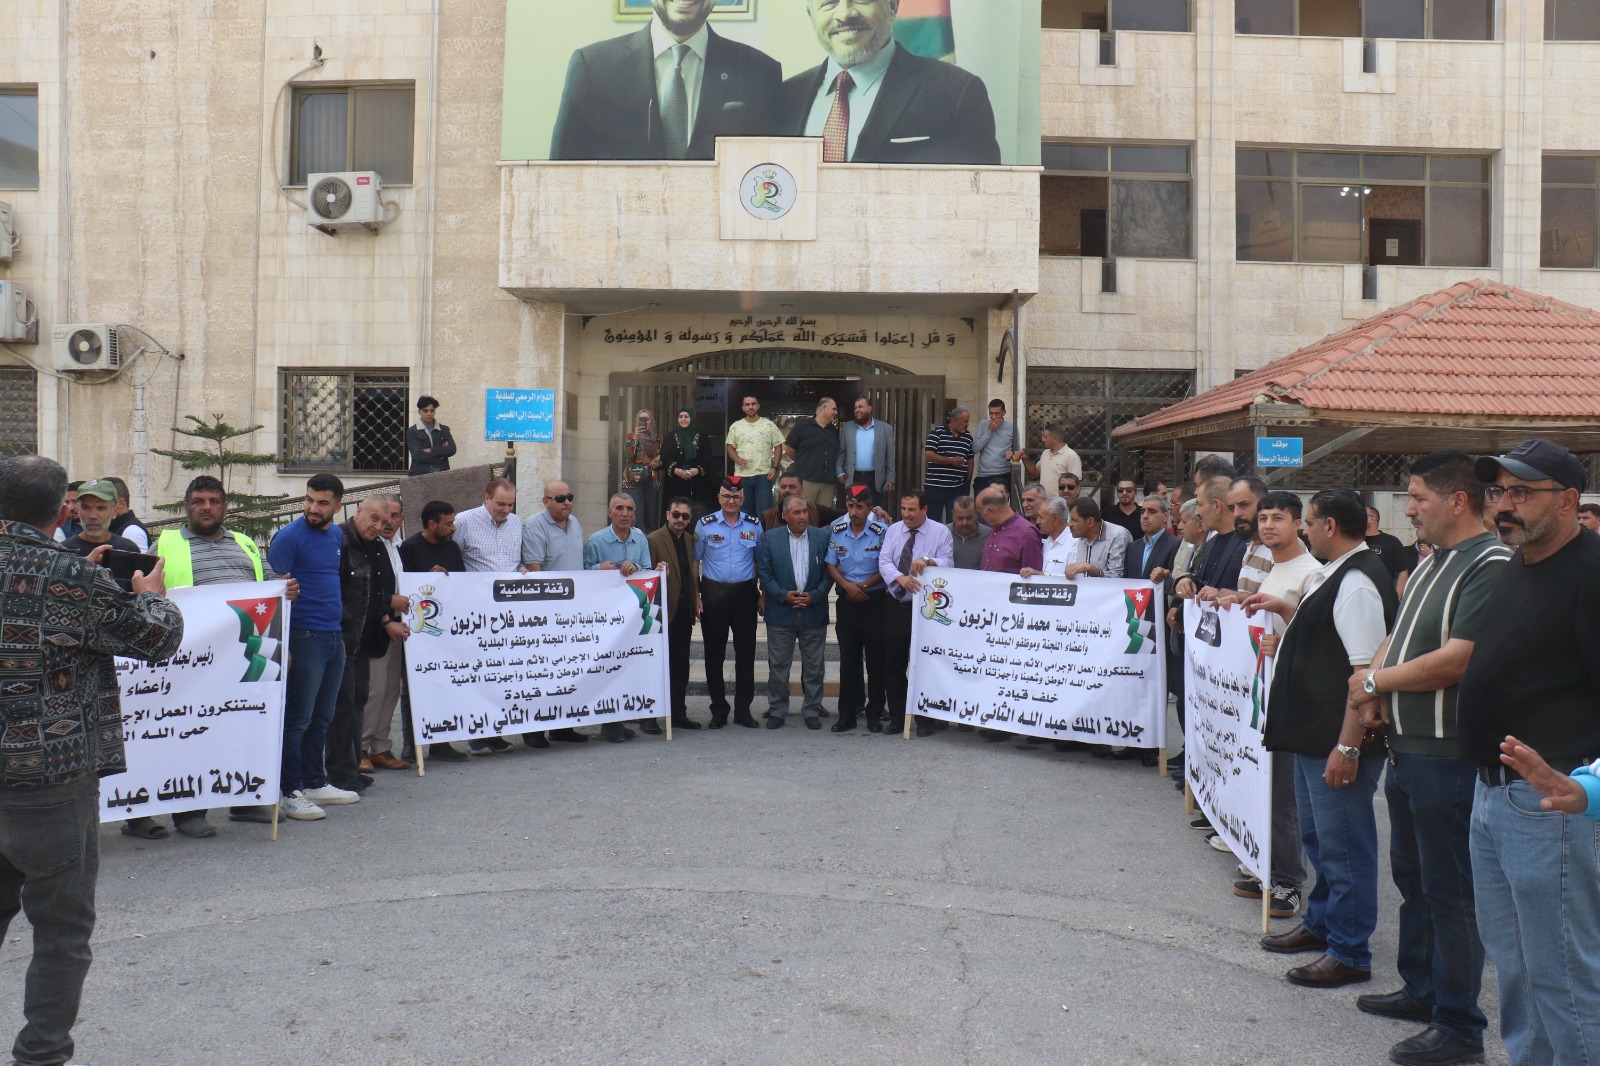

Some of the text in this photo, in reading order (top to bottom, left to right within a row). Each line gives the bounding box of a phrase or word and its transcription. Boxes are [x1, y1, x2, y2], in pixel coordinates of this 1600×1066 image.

[1272, 440, 1288, 448] موقف
[1277, 454, 1290, 464] بلدية
[1290, 454, 1302, 463] رئيس
[499, 581, 569, 598] وقفة تضامنية
[1016, 586, 1072, 602] وقفة تضامنية
[450, 610, 624, 636] رئيس لجنة بلدية الرصيفة محمد فلاح الزبون
[959, 608, 997, 631] الزبون
[1000, 612, 1024, 632] فلاح
[1026, 617, 1050, 631] محمد
[477, 633, 599, 651] وأعضاء اللجنة وموظفو البلدية
[986, 632, 1088, 656] وأعضاء اللجنة وموظفو البلدية
[192, 645, 214, 668] رئيس
[594, 650, 614, 662] العمل
[616, 648, 653, 660] يستنكرون
[920, 646, 945, 656] الكرك
[948, 650, 974, 660] مدينة
[443, 660, 469, 670] مدينة
[472, 660, 482, 670] في
[486, 656, 505, 668] أهلنا
[508, 656, 523, 666] ضد
[976, 654, 987, 664] في
[989, 654, 1008, 665] أهلنا
[1009, 658, 1021, 666] ضد
[415, 662, 440, 673] الكرك
[1077, 664, 1096, 675] العمل
[1097, 666, 1144, 678] يستنكرون
[450, 664, 622, 687] حمى الله الوطن وشعبنا وأجهزتنا الأمنية
[953, 662, 1103, 690] حمى الله الوطن وشعبنا وأجهزتنا الأمنية
[126, 676, 172, 697] وأعضاء
[504, 684, 577, 700] خلف قيادة
[998, 686, 1059, 704] خلف قيادة
[154, 704, 192, 722] العمل
[197, 698, 266, 718] يستنكرون
[421, 694, 656, 739] جلالة الملك عبد الله الثاني ابن الحسين
[917, 692, 1144, 744] جلالة الملك عبد الله الثاني ابن الحسين
[141, 727, 174, 740] الله
[179, 726, 209, 740] حمى
[107, 768, 266, 813] جلالة الملك عبد
